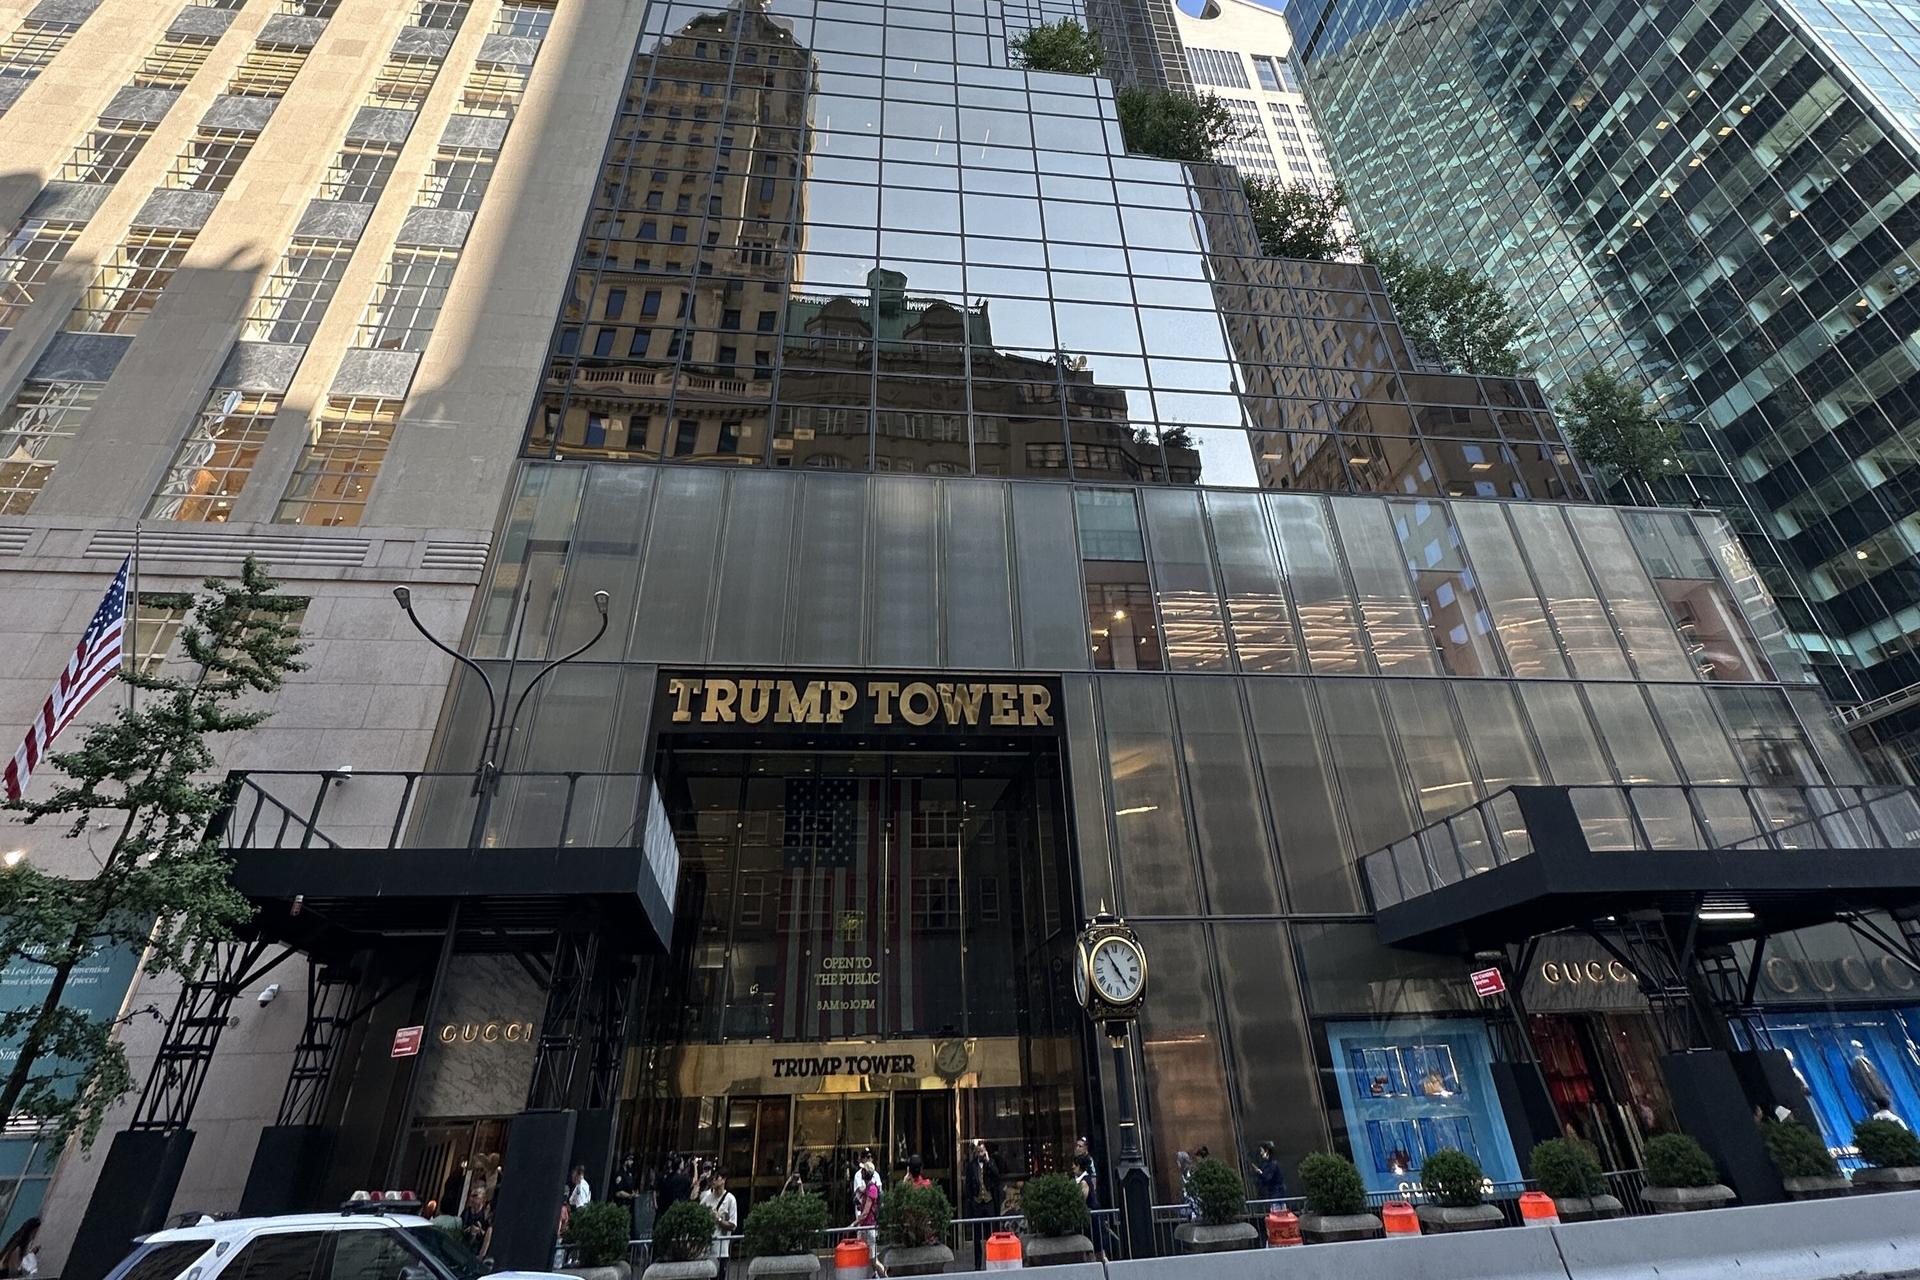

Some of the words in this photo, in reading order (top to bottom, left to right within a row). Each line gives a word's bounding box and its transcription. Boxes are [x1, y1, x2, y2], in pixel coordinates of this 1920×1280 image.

[669, 679, 857, 724] TRUMP
[868, 682, 1054, 726] TOWER
[823, 957, 854, 969] OPEN
[856, 957, 872, 969] TO
[815, 973, 838, 985] THE
[839, 973, 880, 985] PUBLIC
[823, 1000, 840, 1010] AM
[841, 1001, 849, 1010] to
[850, 1000, 861, 1010] 10
[860, 1000, 876, 1009] PM
[440, 1022, 533, 1043] GUCCI
[772, 1057, 842, 1077] TRUMP
[845, 1055, 915, 1075] TOWER
